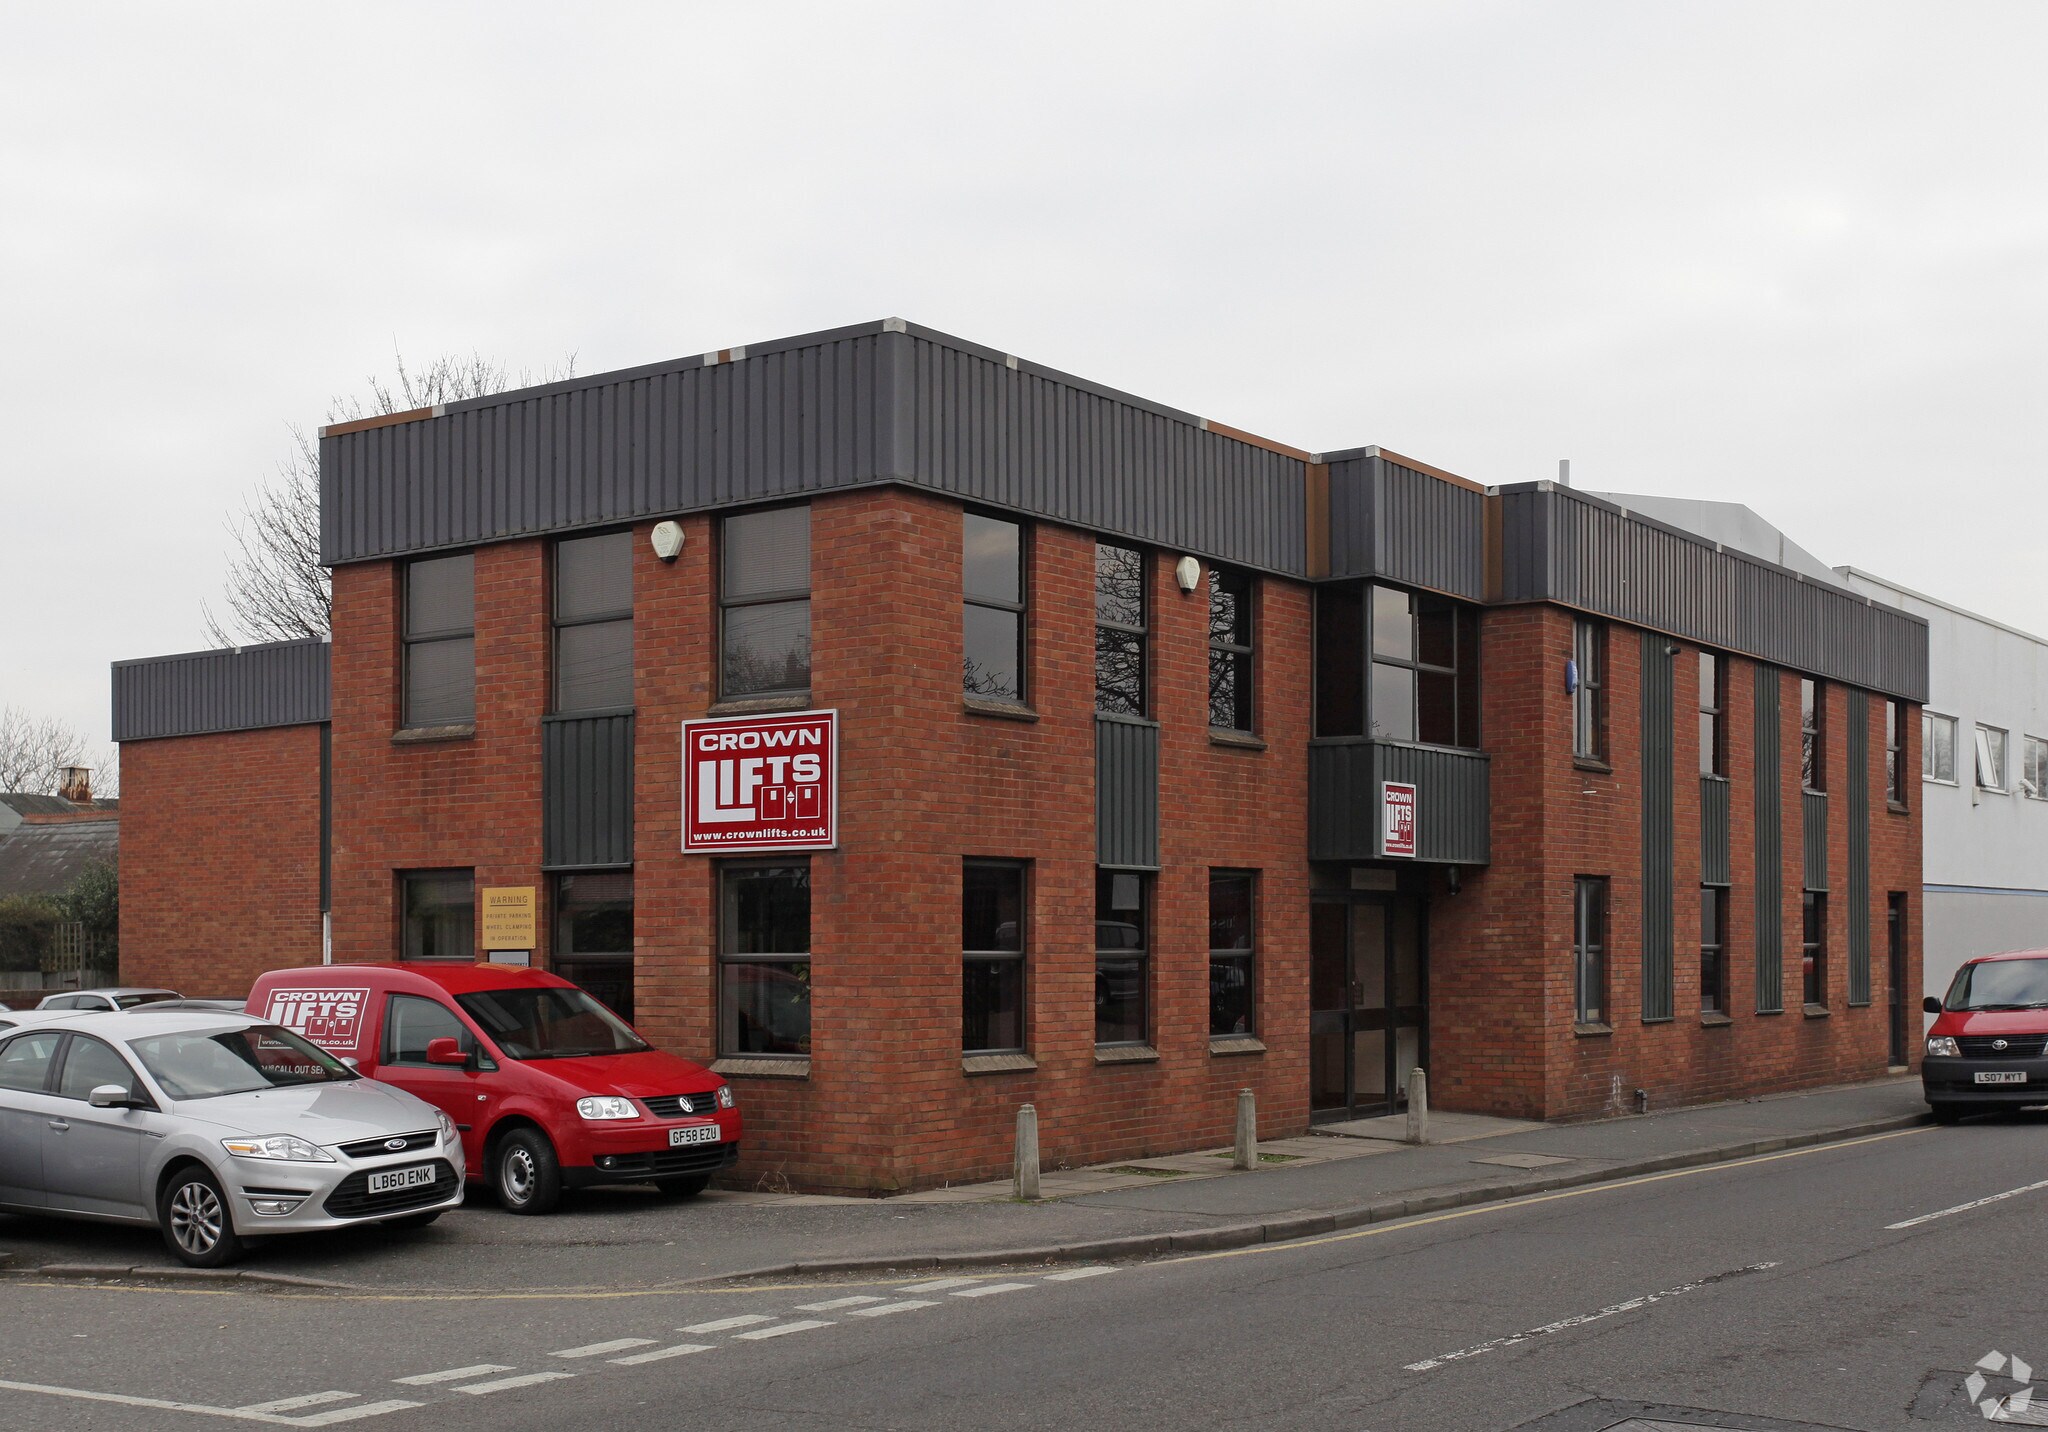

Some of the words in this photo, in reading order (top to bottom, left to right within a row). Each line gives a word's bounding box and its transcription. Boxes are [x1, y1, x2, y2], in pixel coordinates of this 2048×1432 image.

[699, 728, 821, 752] CROWN
[698, 753, 821, 823] LIFTS
[1386, 791, 1412, 804] CROWN
[1386, 803, 1412, 840] LIFTS
[694, 827, 826, 841] www.crownlifts.co.uk
[490, 895, 528, 904] WARNING
[275, 992, 361, 1002] CROWN
[269, 1002, 358, 1035] LIFTS
[275, 1065, 293, 1074] CALL
[294, 1065, 310, 1074] OUT
[1978, 1073, 2002, 1082] LS07
[2004, 1072, 2023, 1081] MYT
[672, 1129, 698, 1144] GF58
[699, 1127, 717, 1141] EZU
[373, 1172, 405, 1191] LB60
[408, 1168, 431, 1184] ENK
